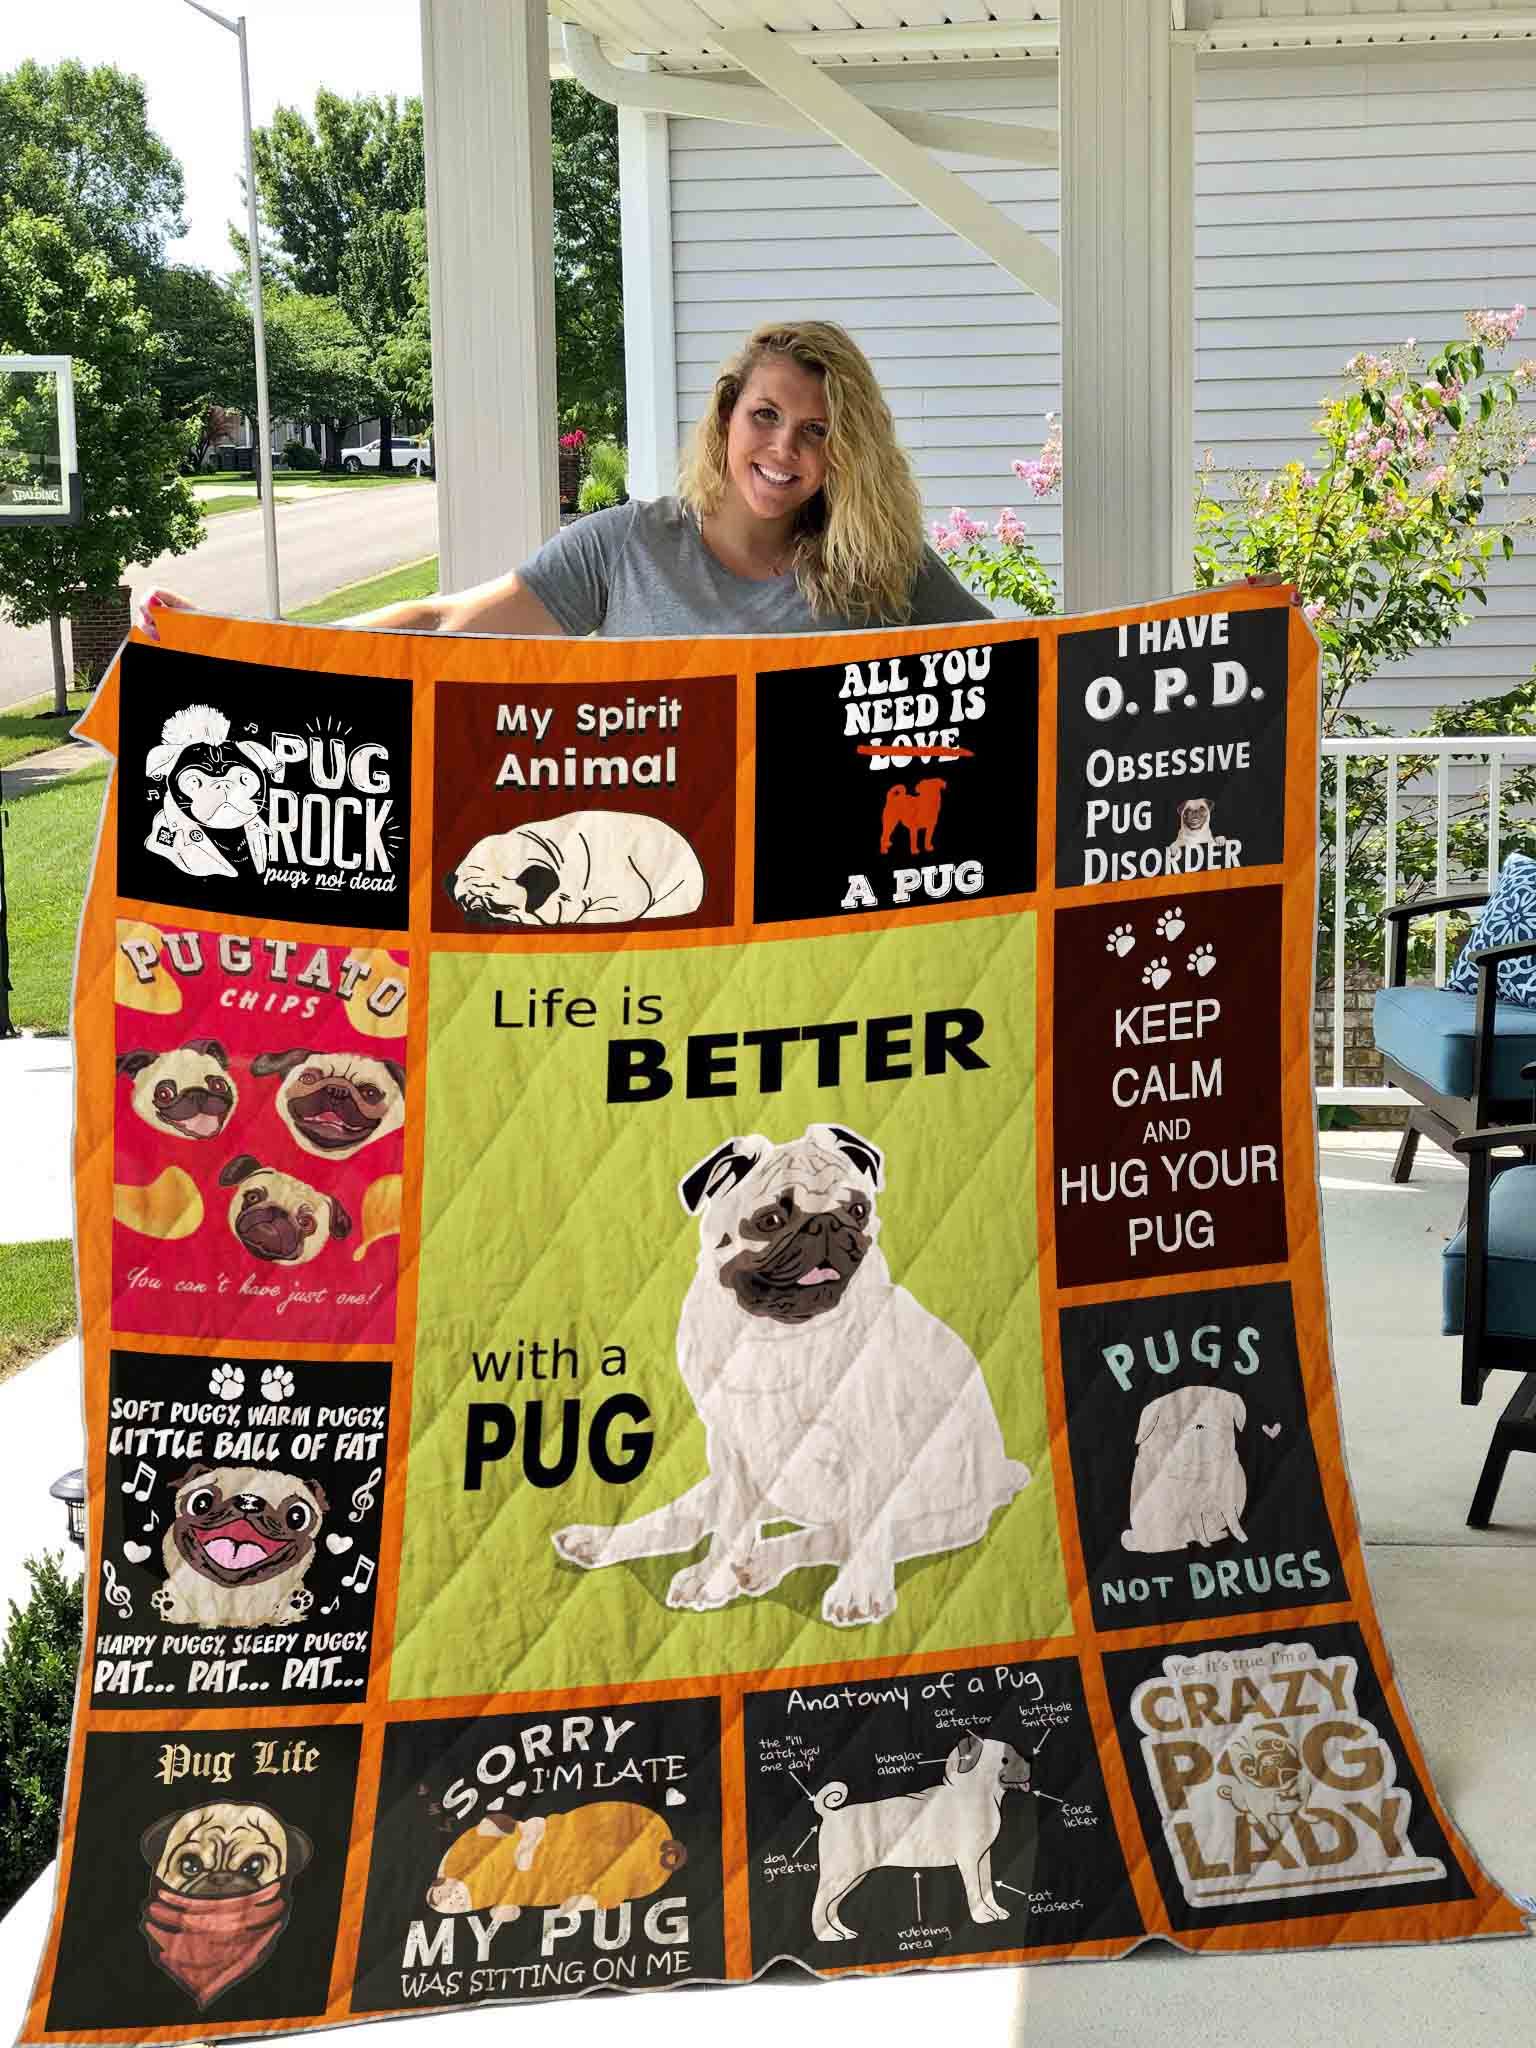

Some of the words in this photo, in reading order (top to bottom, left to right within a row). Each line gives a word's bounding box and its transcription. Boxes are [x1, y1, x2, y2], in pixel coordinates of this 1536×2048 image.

[12, 489, 59, 501] SPALDING
[1118, 624, 1128, 657] I
[1139, 612, 1229, 654] HAVE
[838, 658, 909, 698] ALL
[920, 646, 992, 688] YOU
[496, 704, 553, 740] My
[576, 696, 682, 738] Spirit
[844, 693, 939, 736] NEED
[950, 686, 986, 722] IS
[271, 732, 391, 794] PUG
[496, 747, 677, 789] Animal
[869, 728, 960, 770] LOVE
[1085, 741, 1250, 788] OBSESSIVE
[269, 788, 393, 872] ROCK
[1086, 799, 1152, 838] PUG
[315, 870, 346, 888] not
[349, 872, 397, 892] dead
[1083, 839, 1243, 886] DISORDER
[841, 874, 878, 909] A
[892, 859, 984, 903] PUG
[120, 931, 406, 1018] PUGTATO
[220, 987, 320, 1019] CHIPS
[494, 989, 597, 1028] Life
[622, 986, 664, 1025] is
[1115, 998, 1221, 1048] KEEP
[607, 1007, 991, 1104] BETTER
[1111, 1058, 1222, 1108] CALM
[1142, 1118, 1191, 1145] AND
[1060, 1158, 1149, 1206] HUG
[1161, 1144, 1279, 1192] YOUR
[1128, 1209, 1215, 1256] PUG
[127, 1266, 161, 1289] You
[238, 1273, 280, 1297] have
[276, 1281, 328, 1315] just
[336, 1283, 383, 1305] one!
[472, 1338, 578, 1382] with
[600, 1345, 627, 1377] a
[1102, 1325, 1261, 1392] PUGS
[110, 1397, 165, 1422] SOFT
[170, 1401, 241, 1429] PUGGY,
[248, 1404, 311, 1428] WARM
[316, 1406, 385, 1430] PUGGY,
[108, 1425, 204, 1460] LITTLE
[212, 1430, 280, 1463] BALL
[290, 1433, 329, 1462] OF
[334, 1433, 384, 1462] FAT
[463, 1392, 654, 1491] PUG
[1101, 1576, 1174, 1606] NOT
[1189, 1549, 1331, 1600] DRUGS
[96, 1634, 156, 1657] HAPPY
[162, 1634, 226, 1657] PUGGY,
[232, 1632, 297, 1656] SLEEPY
[304, 1630, 369, 1653] PUGGY,
[93, 1659, 176, 1695] PAT...
[187, 1657, 270, 1695] PAT...
[281, 1655, 364, 1690] PAT...
[786, 1689, 909, 1714] Anatomy
[921, 1674, 955, 1700] of
[967, 1676, 985, 1695] a
[994, 1666, 1044, 1701] Pug
[934, 1708, 956, 1717] car
[1019, 1703, 1073, 1716] butthole
[1140, 1664, 1349, 1733] CRAZY
[936, 1714, 992, 1729] detector
[1021, 1713, 1070, 1728] sniffer
[154, 1743, 236, 1785] Pug
[251, 1739, 321, 1775] Life
[759, 1739, 781, 1749] the
[760, 1749, 796, 1761] catch
[799, 1746, 820, 1760] you
[760, 1763, 783, 1773] one
[788, 1757, 815, 1772] day"
[875, 1752, 923, 1767] burglar
[442, 1715, 637, 1821] SORRY
[531, 1763, 584, 1794] I'M
[592, 1756, 689, 1788] LATE
[877, 1764, 914, 1776] alarm
[1151, 1720, 1384, 1811] PG
[1062, 1803, 1093, 1816] face
[1063, 1813, 1099, 1829] licker
[764, 1853, 787, 1867] dog
[1174, 1797, 1404, 1882] LADY
[764, 1861, 818, 1883] greeter
[1028, 1889, 1053, 1902] cat
[1030, 1898, 1084, 1914] chasers
[402, 1914, 508, 1969] MY
[540, 1897, 689, 1957] PUG
[897, 1924, 952, 1941] rubbing
[899, 1938, 933, 1951] area
[401, 1971, 463, 1999] WAS
[469, 1961, 584, 1996] SITTING
[592, 1955, 638, 1982] ON
[646, 1951, 692, 1976] ME
